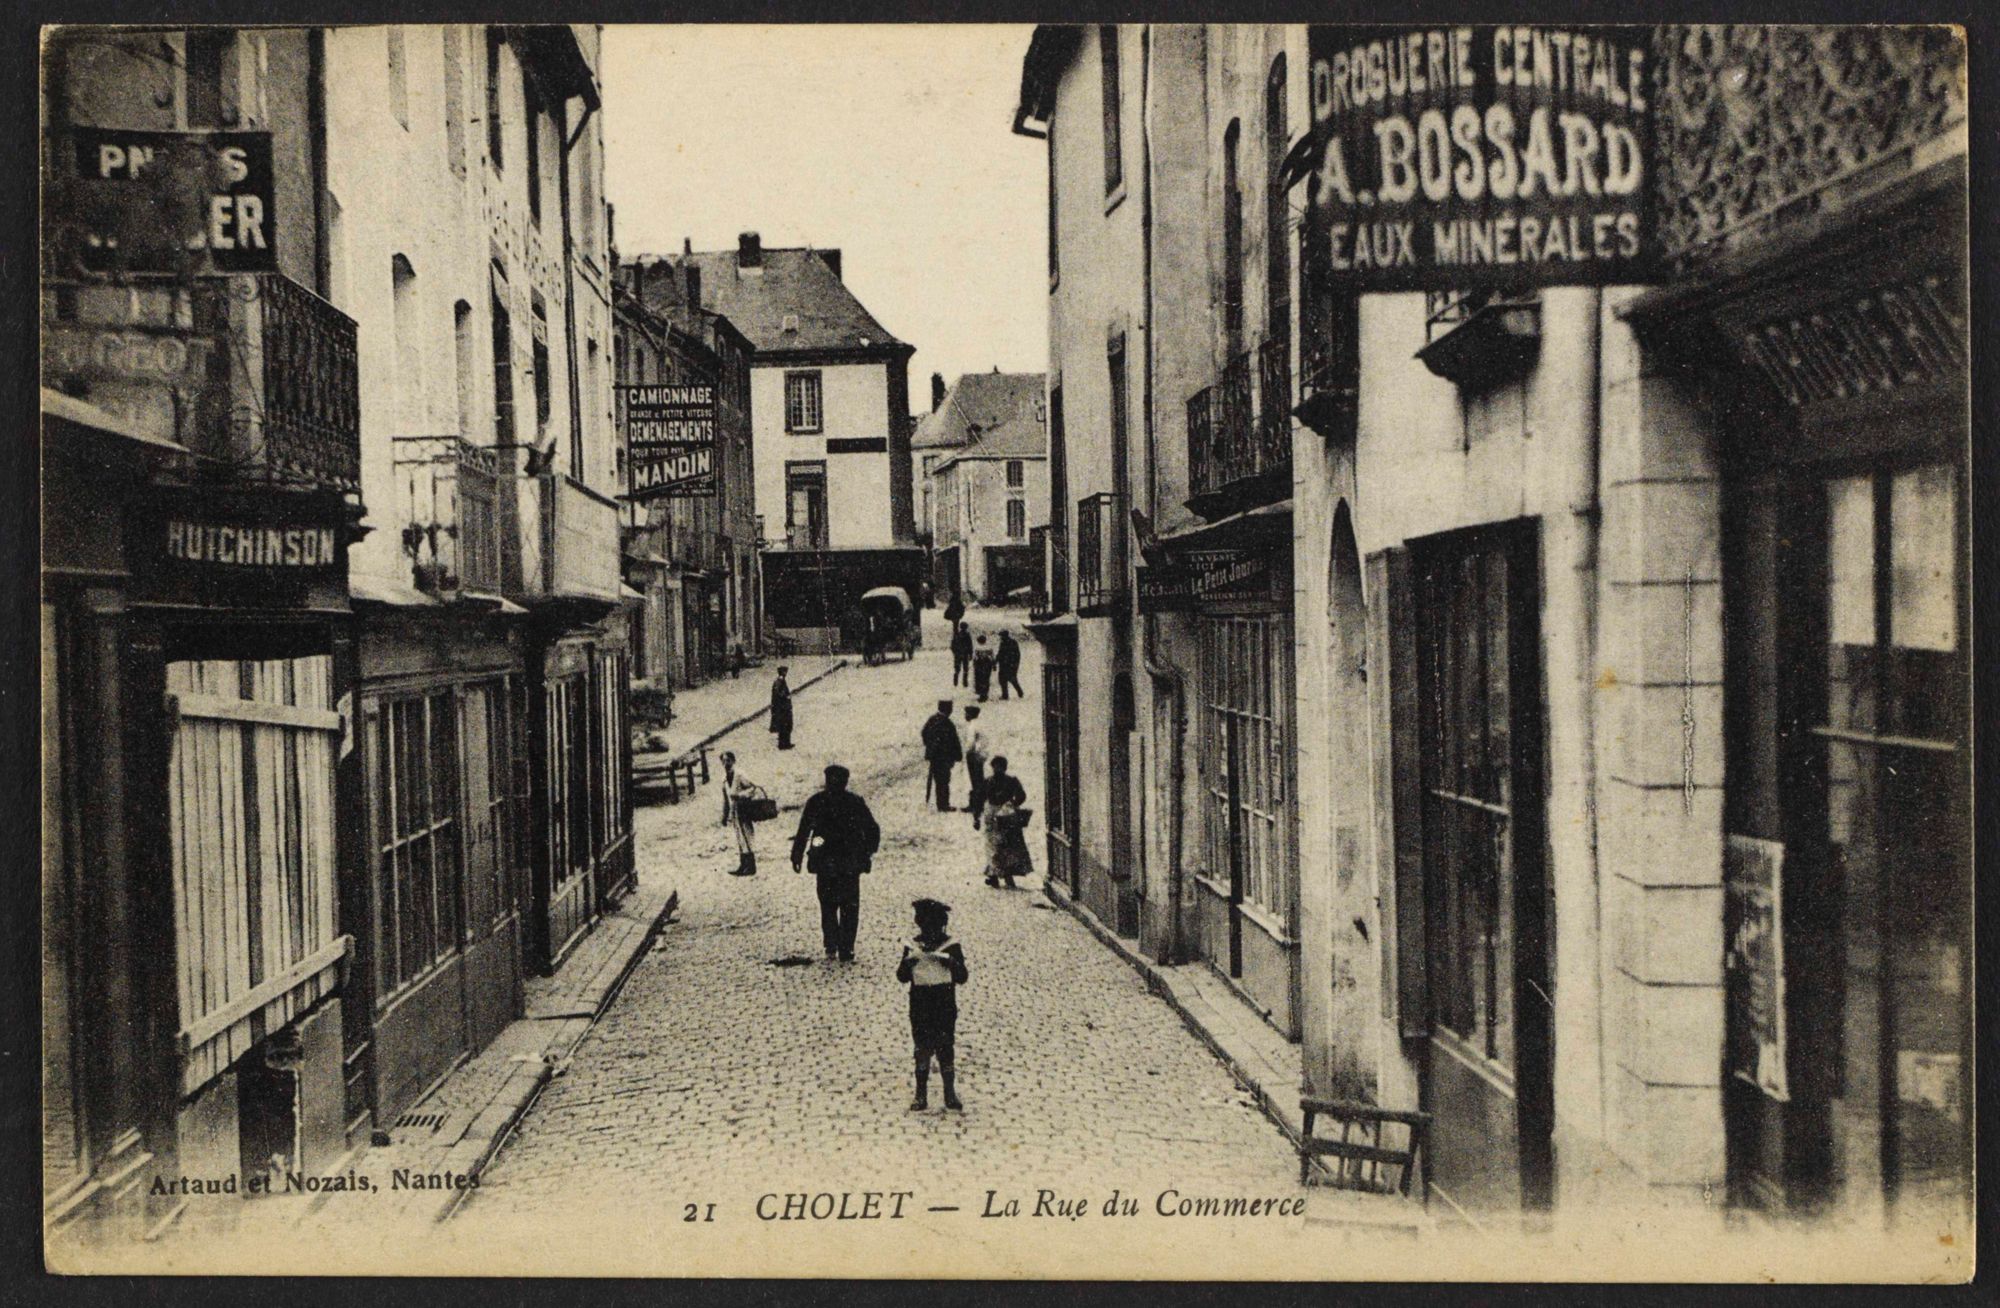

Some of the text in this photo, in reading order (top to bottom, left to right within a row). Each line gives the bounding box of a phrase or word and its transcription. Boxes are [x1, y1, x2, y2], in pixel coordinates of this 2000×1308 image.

[1314, 27, 1646, 122] DROGUERIE CENTRALE
[99, 144, 248, 183] PNS
[1374, 103, 1643, 202] BOSSARD
[1330, 221, 1416, 270] EAUX
[629, 387, 713, 405] CAMIONNAGE
[634, 450, 711, 491] MANDIN
[168, 521, 335, 566] HUTCHINSON
